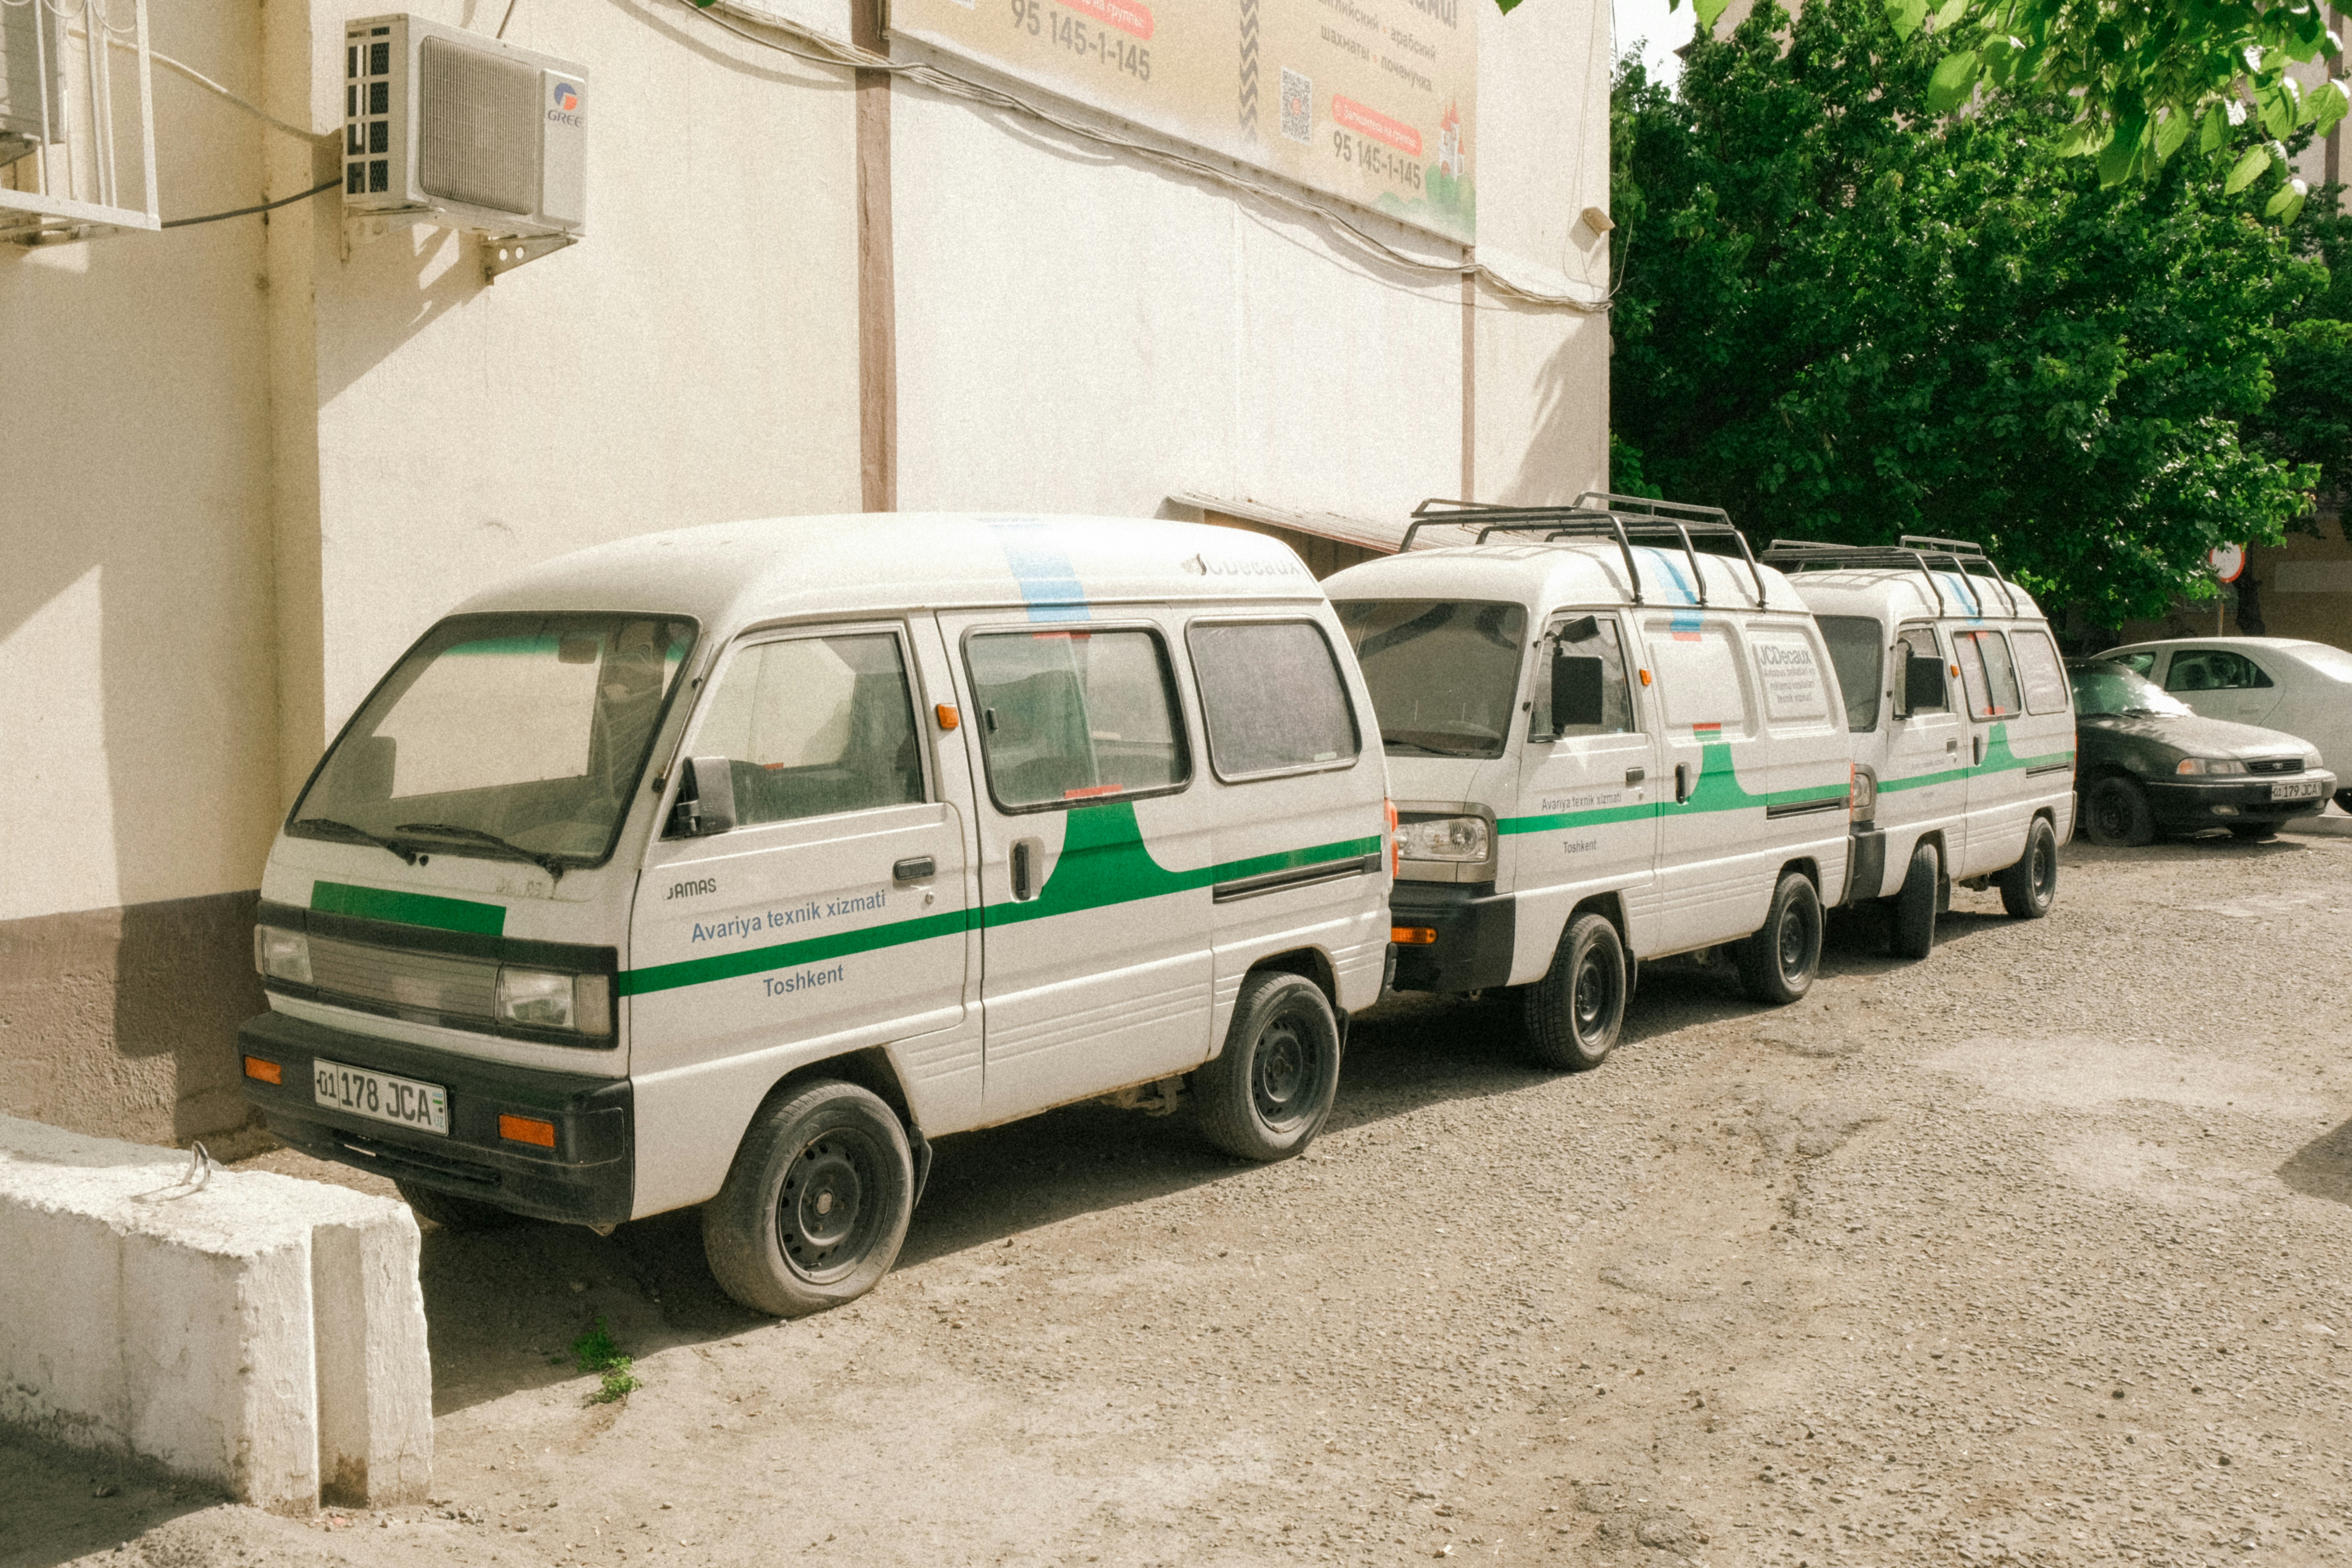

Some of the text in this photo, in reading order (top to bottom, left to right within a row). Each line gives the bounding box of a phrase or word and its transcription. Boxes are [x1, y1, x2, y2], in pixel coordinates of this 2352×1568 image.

[1107, 3, 1145, 29] группы:
[1012, 0, 1150, 81] 95 145-1-145
[1390, 27, 1436, 63] арабский
[1321, 25, 1432, 92] шахматы почемучка
[548, 110, 583, 128] GREE
[1334, 130, 1421, 190] 95 145-1-145
[1760, 645, 1812, 665] JCDecaux
[1573, 794, 1595, 807] texnik
[2283, 785, 2299, 797] 179
[2301, 784, 2317, 796] JCA
[1563, 839, 1597, 854] Toshkent
[691, 889, 886, 943] Avariya texnik xizmati
[763, 965, 844, 997] Toshkent
[318, 1070, 432, 1125] 01 178 JCA
[433, 1114, 444, 1127] UZ
